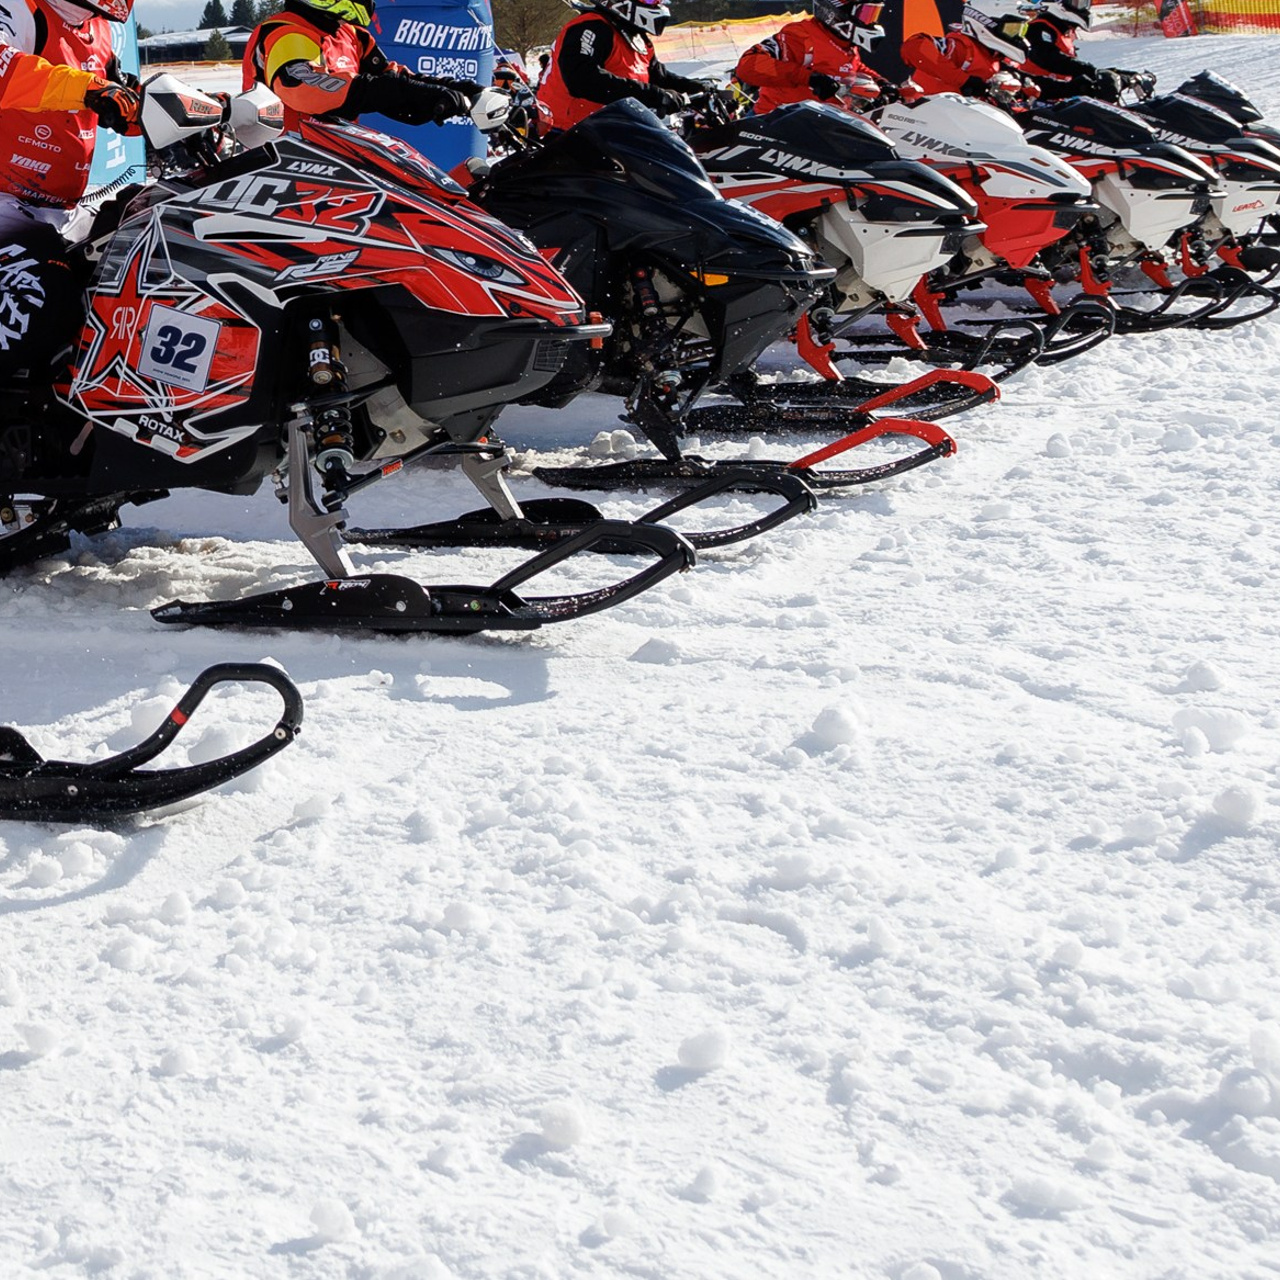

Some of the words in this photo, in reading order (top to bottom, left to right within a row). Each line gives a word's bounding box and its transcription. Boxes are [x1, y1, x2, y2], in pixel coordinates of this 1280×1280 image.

[17, 135, 62, 153] CFMOTO
[900, 130, 953, 155] LYNX
[1049, 132, 1104, 155] LYNX
[9, 153, 52, 174] YOKO
[75, 161, 90, 171] LA
[286, 160, 341, 177] LYNX
[758, 148, 821, 177] LYNX
[149, 324, 208, 374] 32
[138, 414, 185, 443] ROTAX
